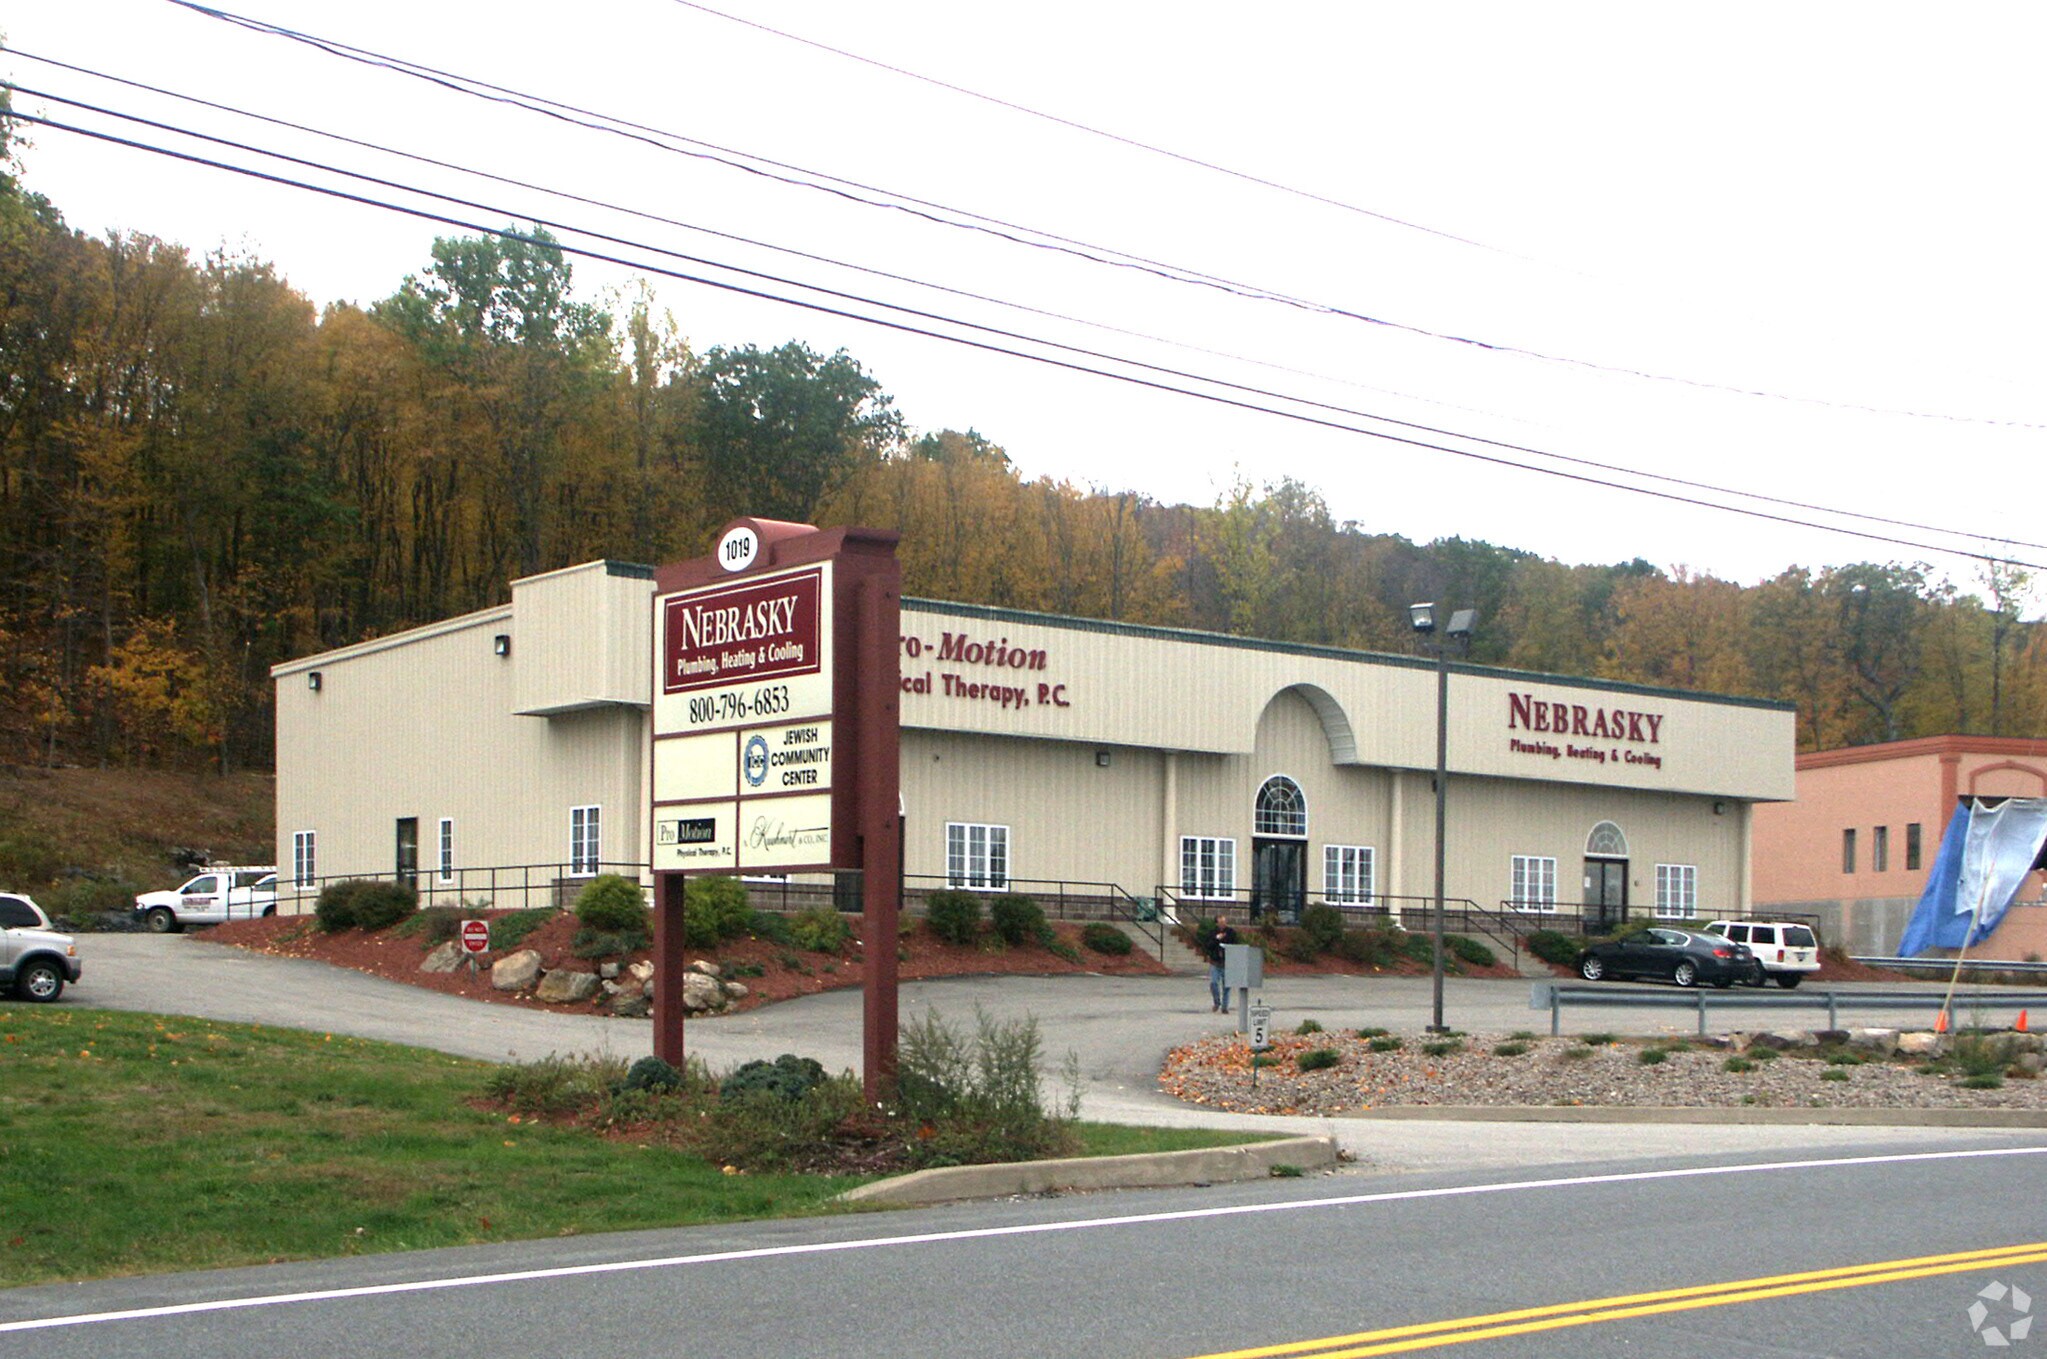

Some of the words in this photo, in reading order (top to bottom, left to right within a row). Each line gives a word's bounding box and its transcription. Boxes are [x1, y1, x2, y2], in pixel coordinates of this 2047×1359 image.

[725, 537, 750, 561] 1019
[681, 595, 798, 650] NEBRASKY
[677, 655, 719, 676] Plumbing,
[721, 648, 755, 669] Heating
[758, 646, 766, 663] &
[768, 641, 803, 662] Cooling
[689, 685, 789, 723] 800-796-6853
[942, 673, 1029, 710] Therapy,
[1508, 692, 1663, 743] NEBRASKY
[783, 728, 818, 745] JEWISH
[771, 747, 830, 767] COMMUNITY
[1510, 738, 1561, 759] Plumbing,
[1566, 744, 1605, 764] Heating
[1611, 749, 1619, 762] &
[1624, 750, 1662, 769] Cooling
[782, 769, 818, 786] CENTER
[660, 824, 675, 841] Pro
[1255, 1027, 1263, 1044] 5
